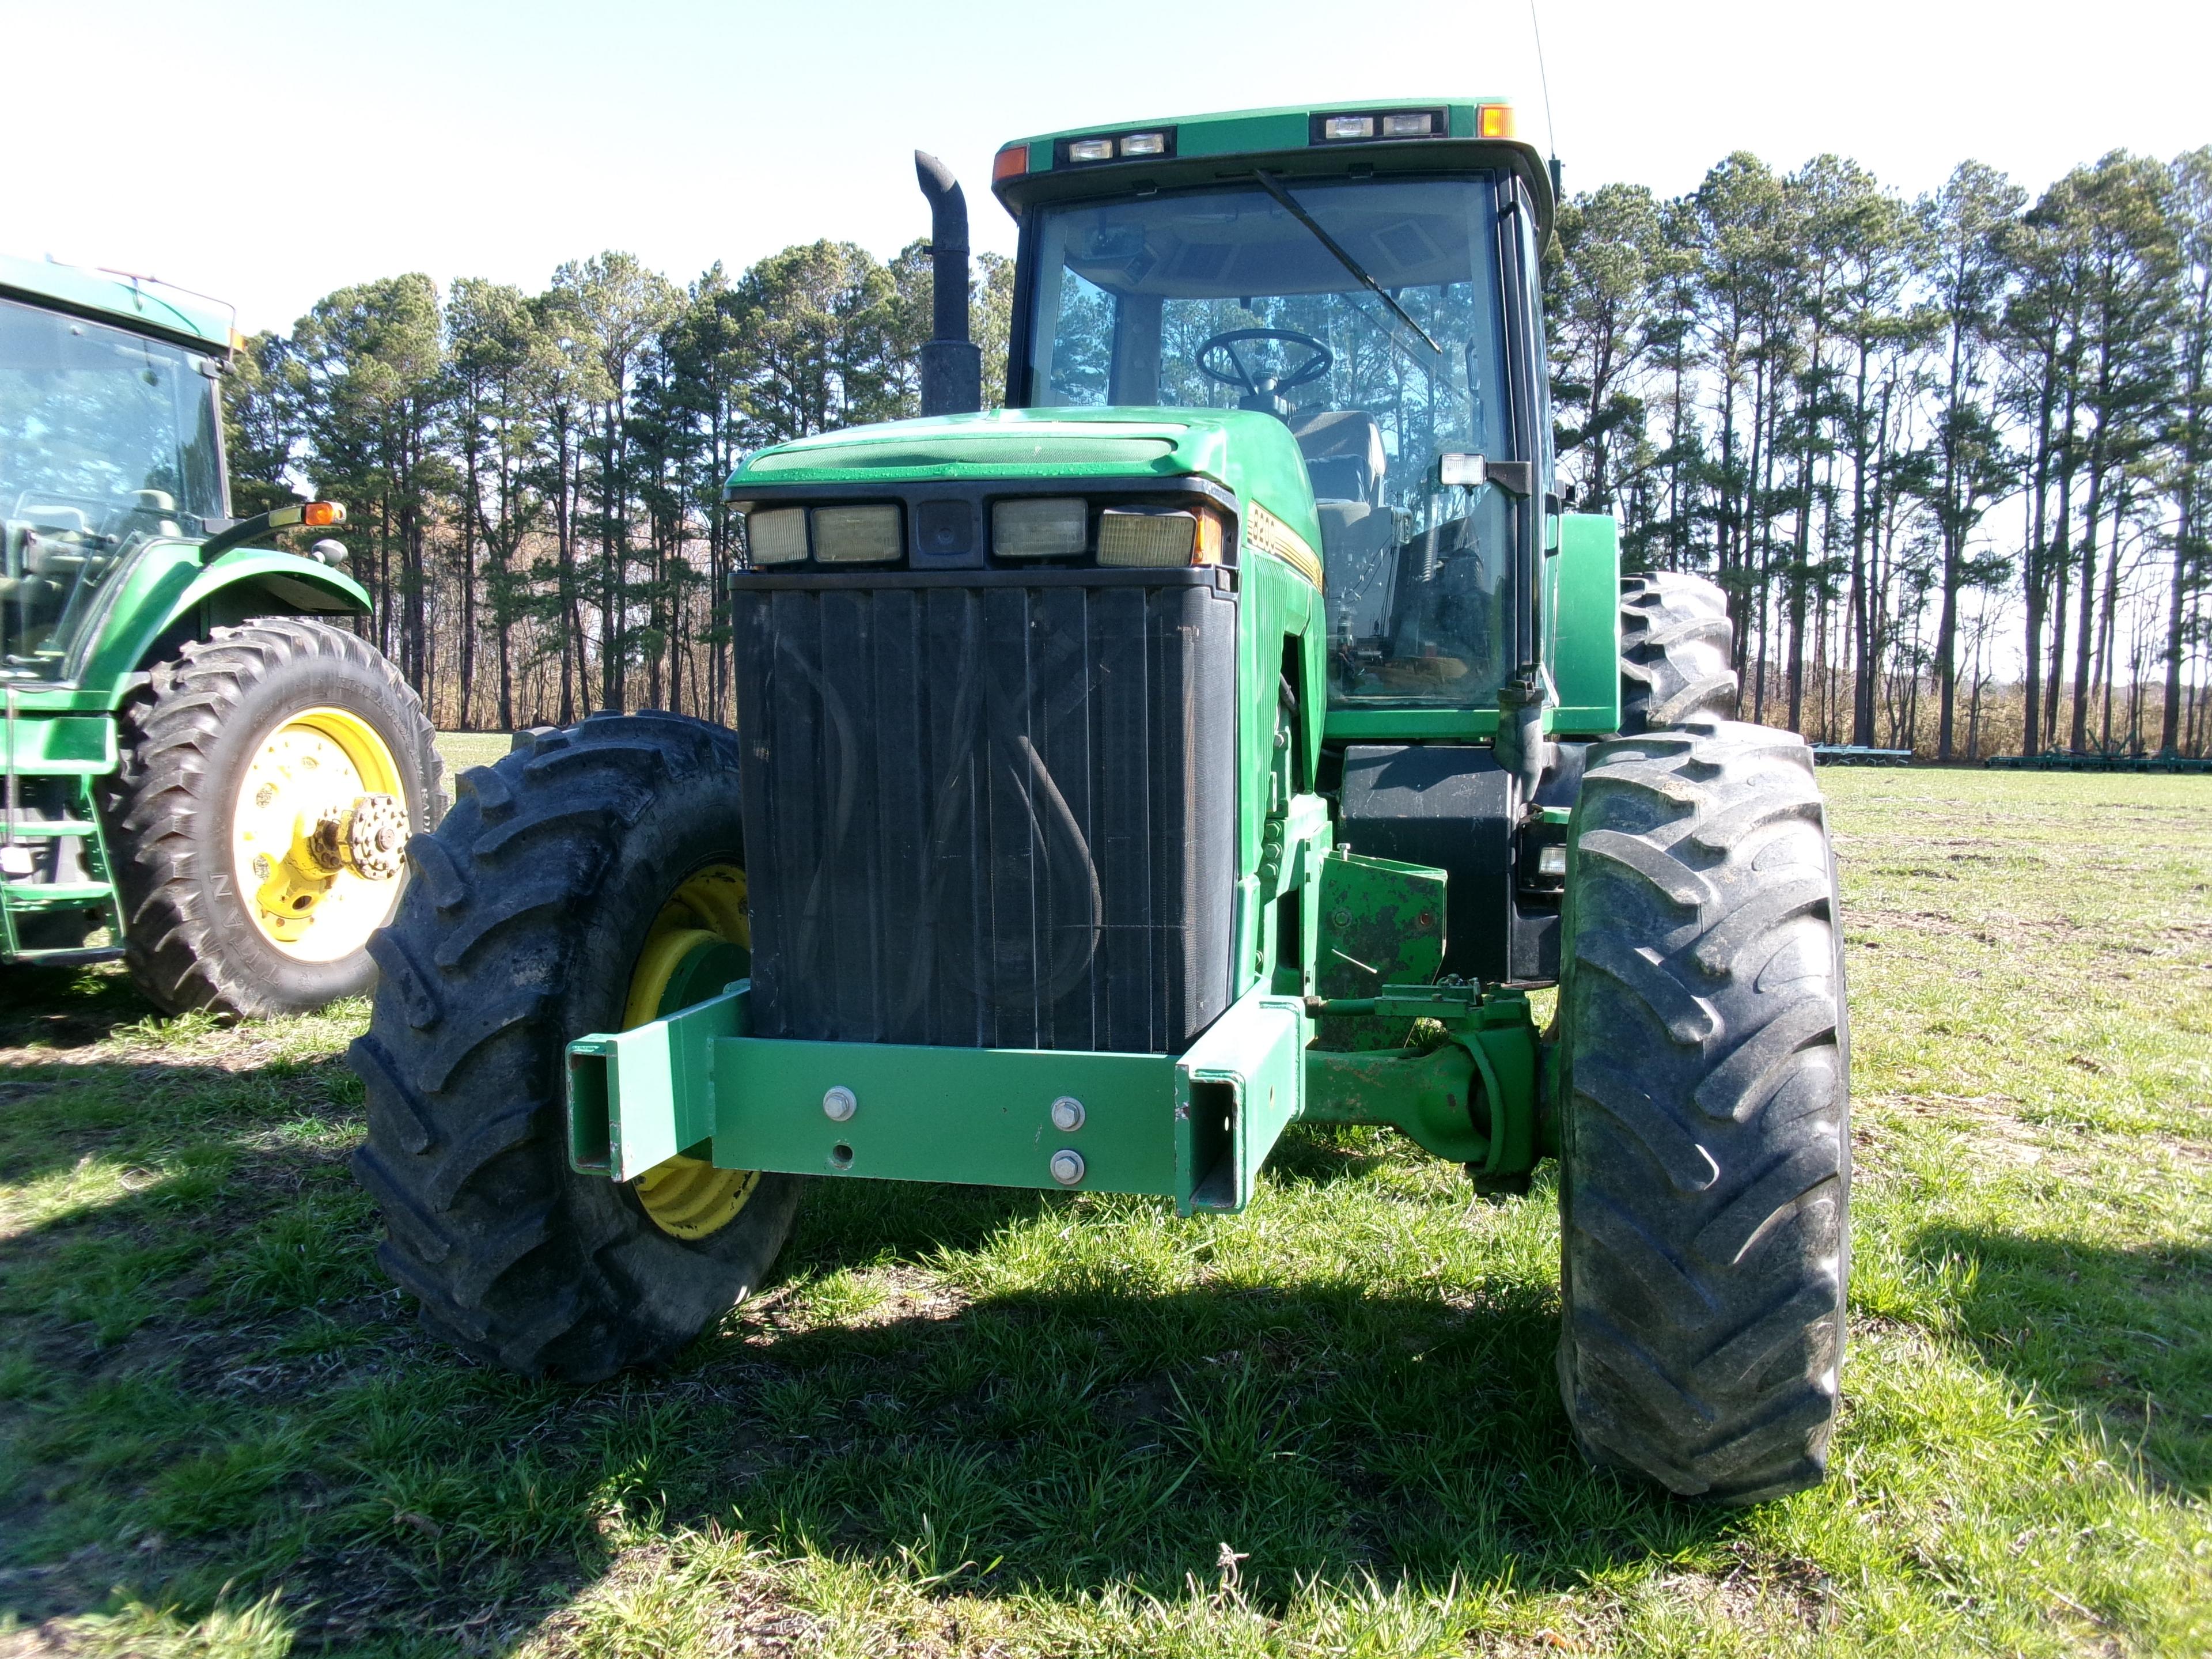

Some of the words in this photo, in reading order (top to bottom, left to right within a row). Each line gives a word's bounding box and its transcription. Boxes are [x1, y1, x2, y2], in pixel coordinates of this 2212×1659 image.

[1253, 509, 1275, 549] 8200
[421, 788, 431, 833] RADI
[209, 871, 281, 989] TITAN
